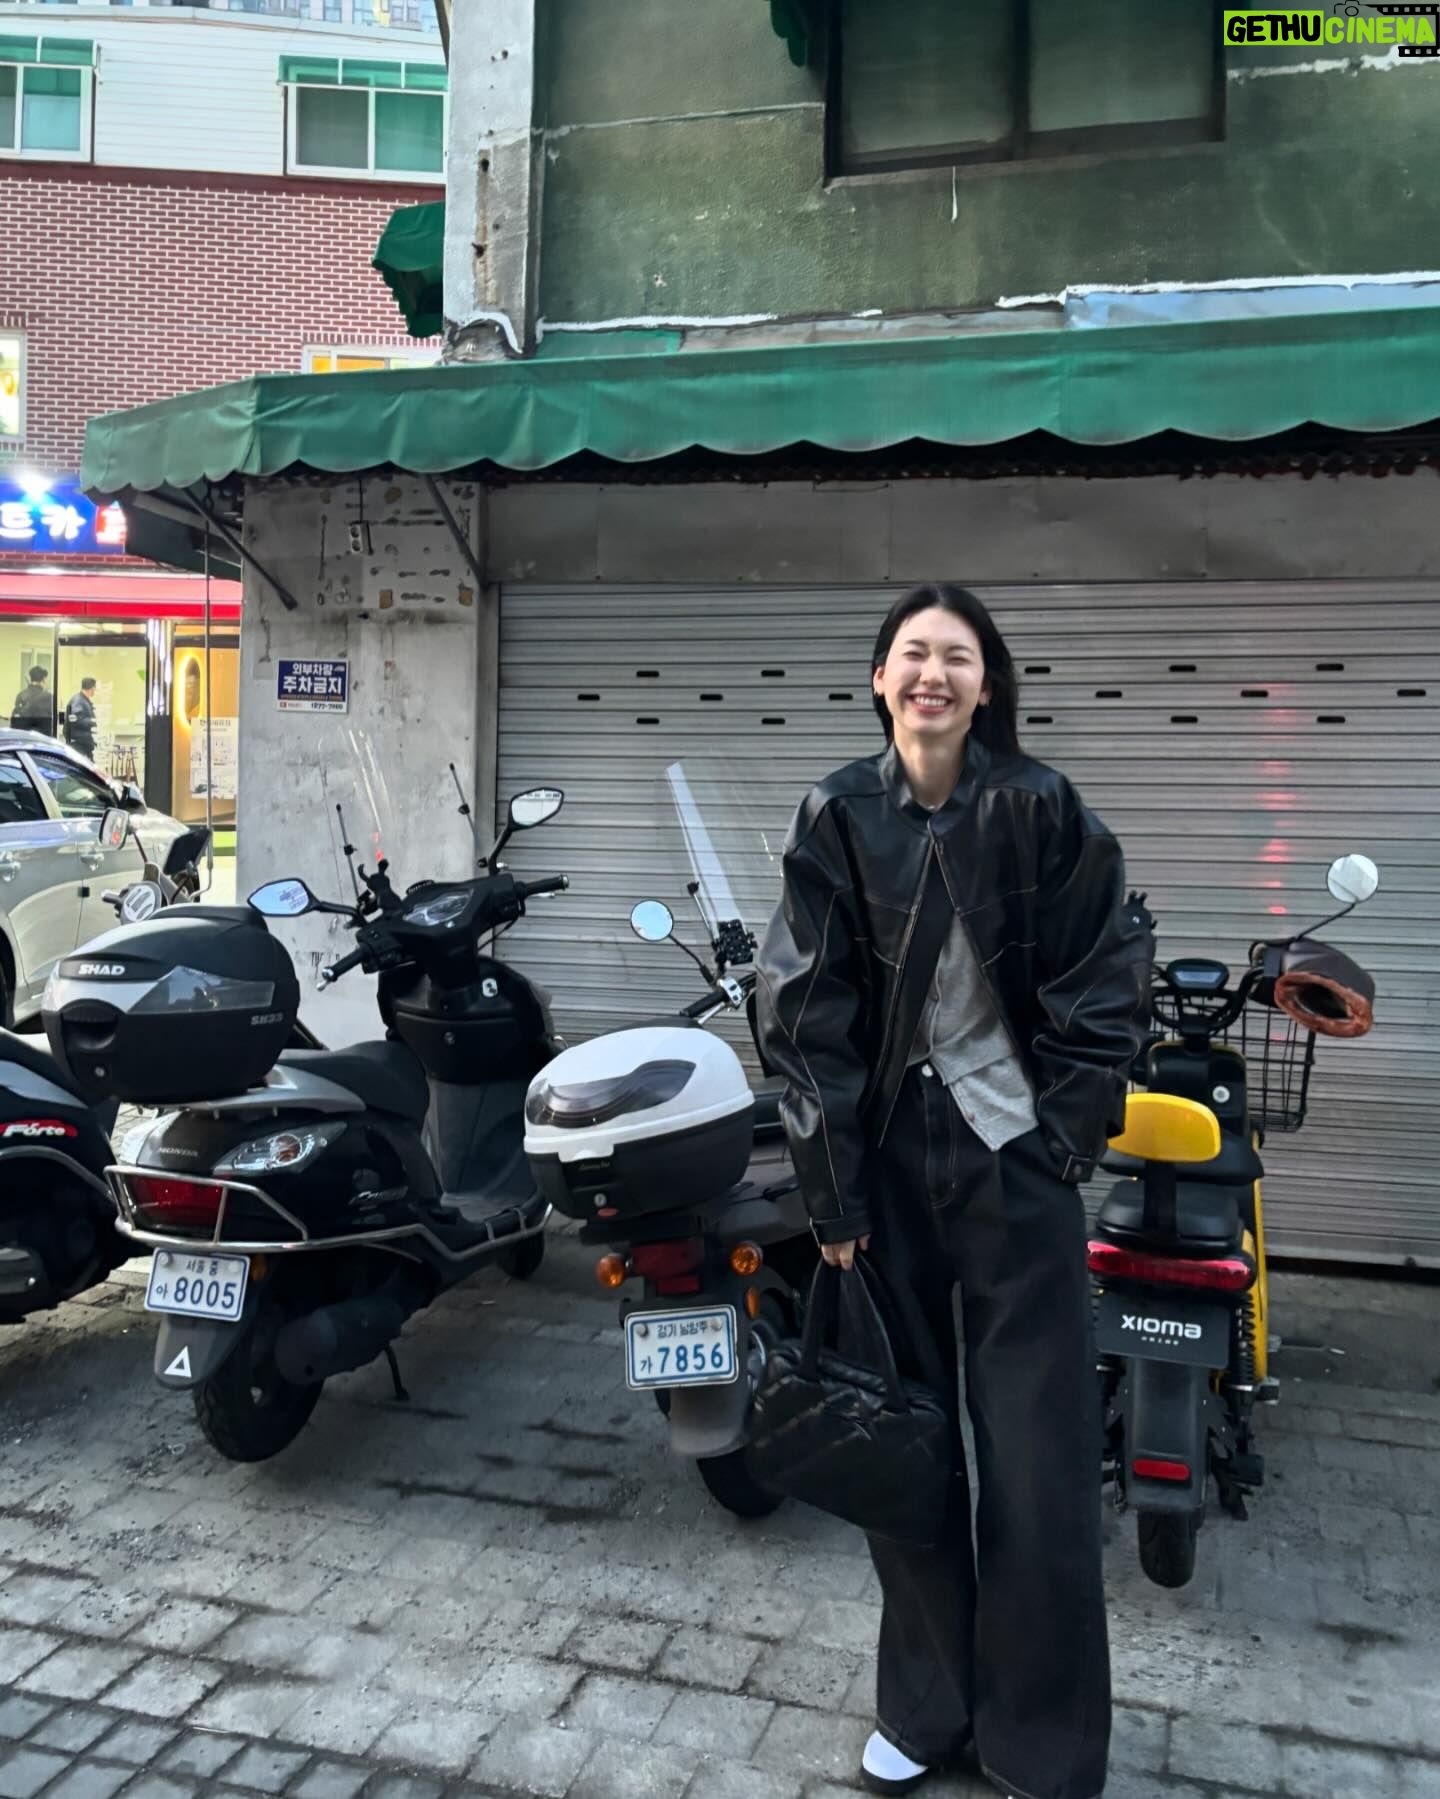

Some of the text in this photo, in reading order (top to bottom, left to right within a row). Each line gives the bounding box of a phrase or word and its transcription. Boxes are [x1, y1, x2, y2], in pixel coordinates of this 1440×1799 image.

[292, 663, 333, 676] 외부차량
[283, 675, 342, 694] 주차금지
[78, 963, 126, 976] SHAD
